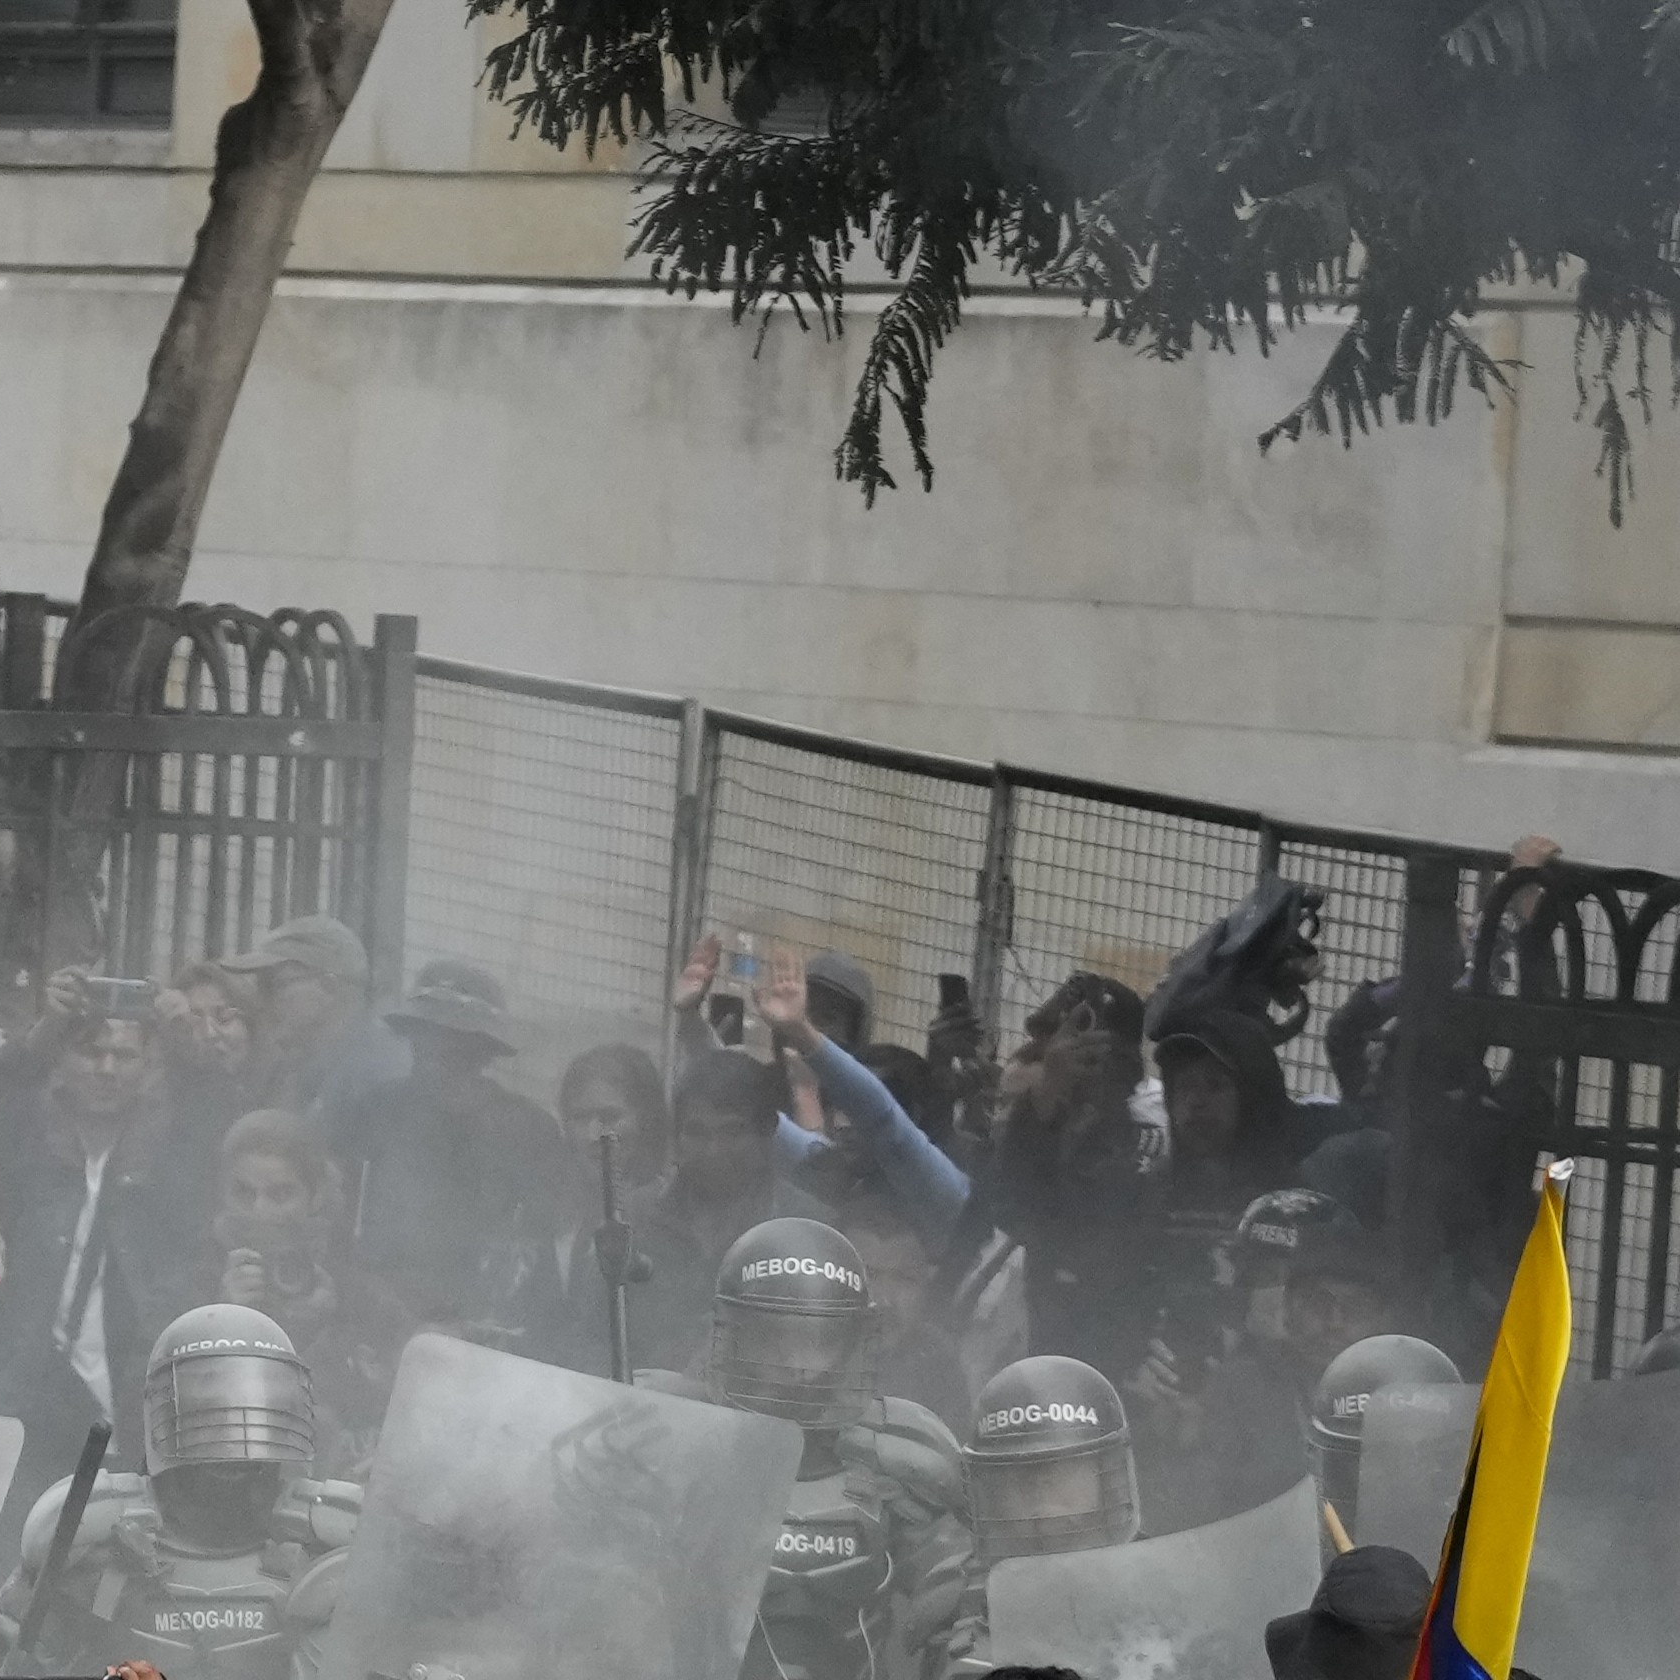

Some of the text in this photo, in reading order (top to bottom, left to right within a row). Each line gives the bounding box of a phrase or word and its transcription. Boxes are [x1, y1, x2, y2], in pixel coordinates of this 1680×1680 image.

[741, 1257, 860, 1292] MEBOG-0419
[978, 1403, 1099, 1434] MEBOG-0044
[154, 1609, 265, 1633] MEBOG-0182
